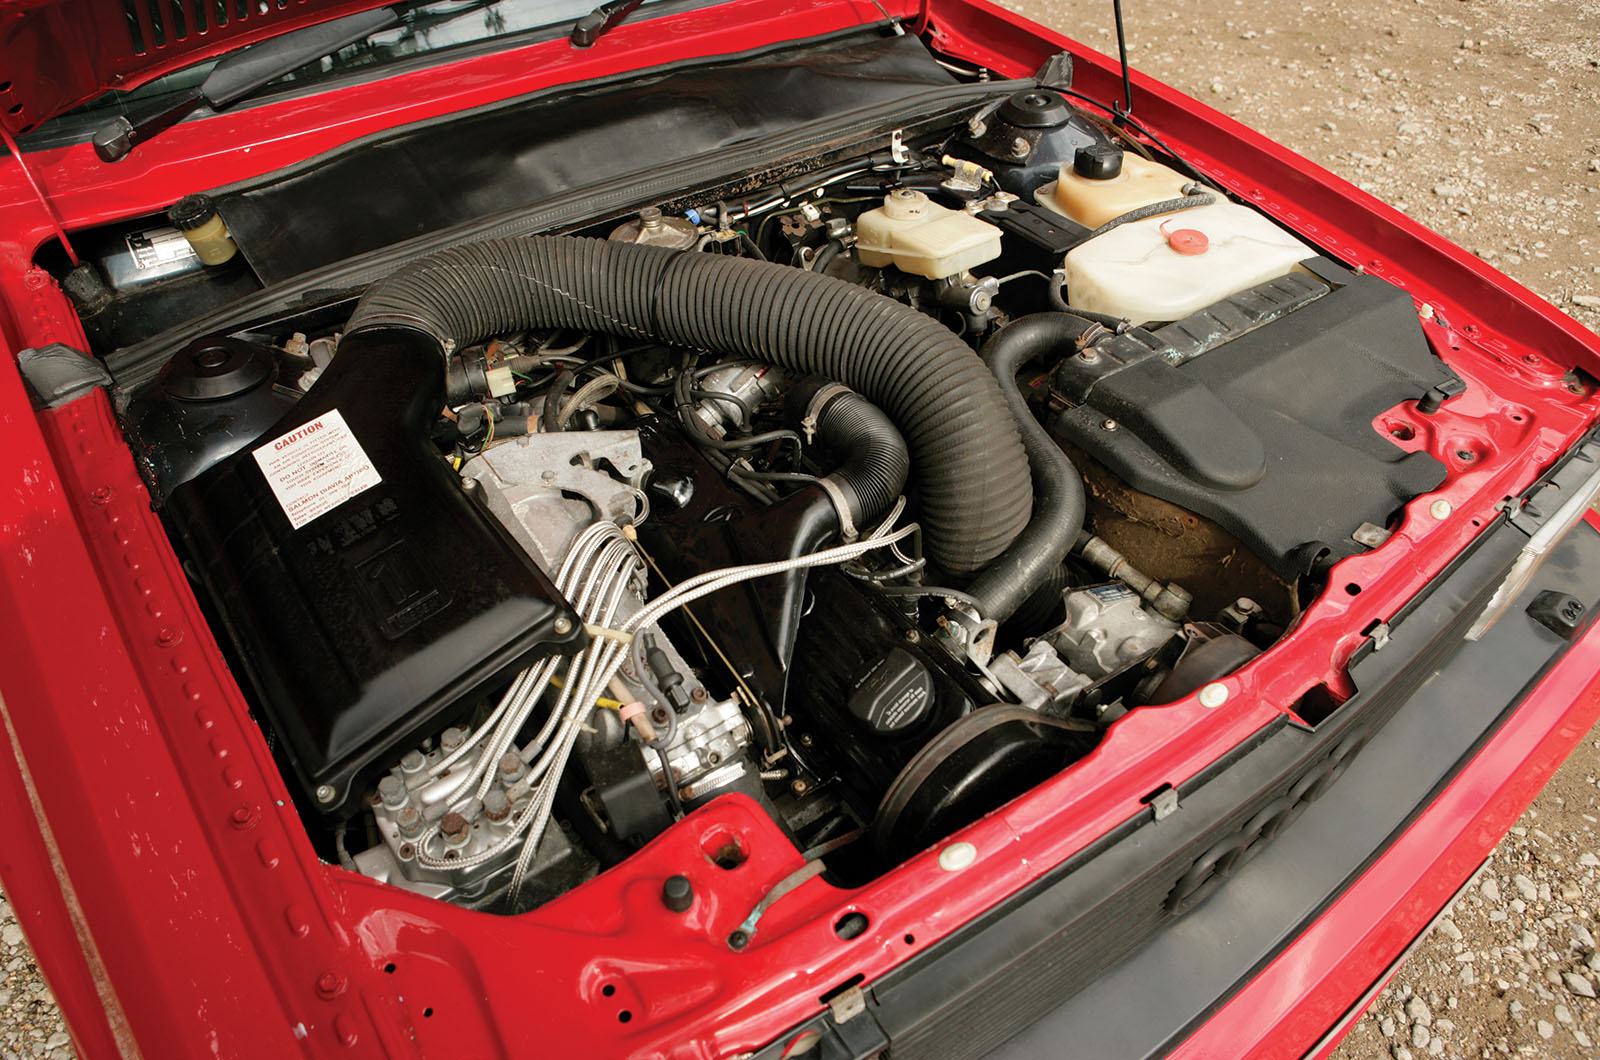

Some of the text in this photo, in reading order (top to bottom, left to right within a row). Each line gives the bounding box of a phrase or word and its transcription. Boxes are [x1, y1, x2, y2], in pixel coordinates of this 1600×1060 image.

[272, 419, 324, 452] CAUTION
[278, 473, 291, 483] DO
[290, 464, 307, 476] NOT
[287, 491, 320, 513] SALMON
[318, 478, 343, 495] DIAVIA
